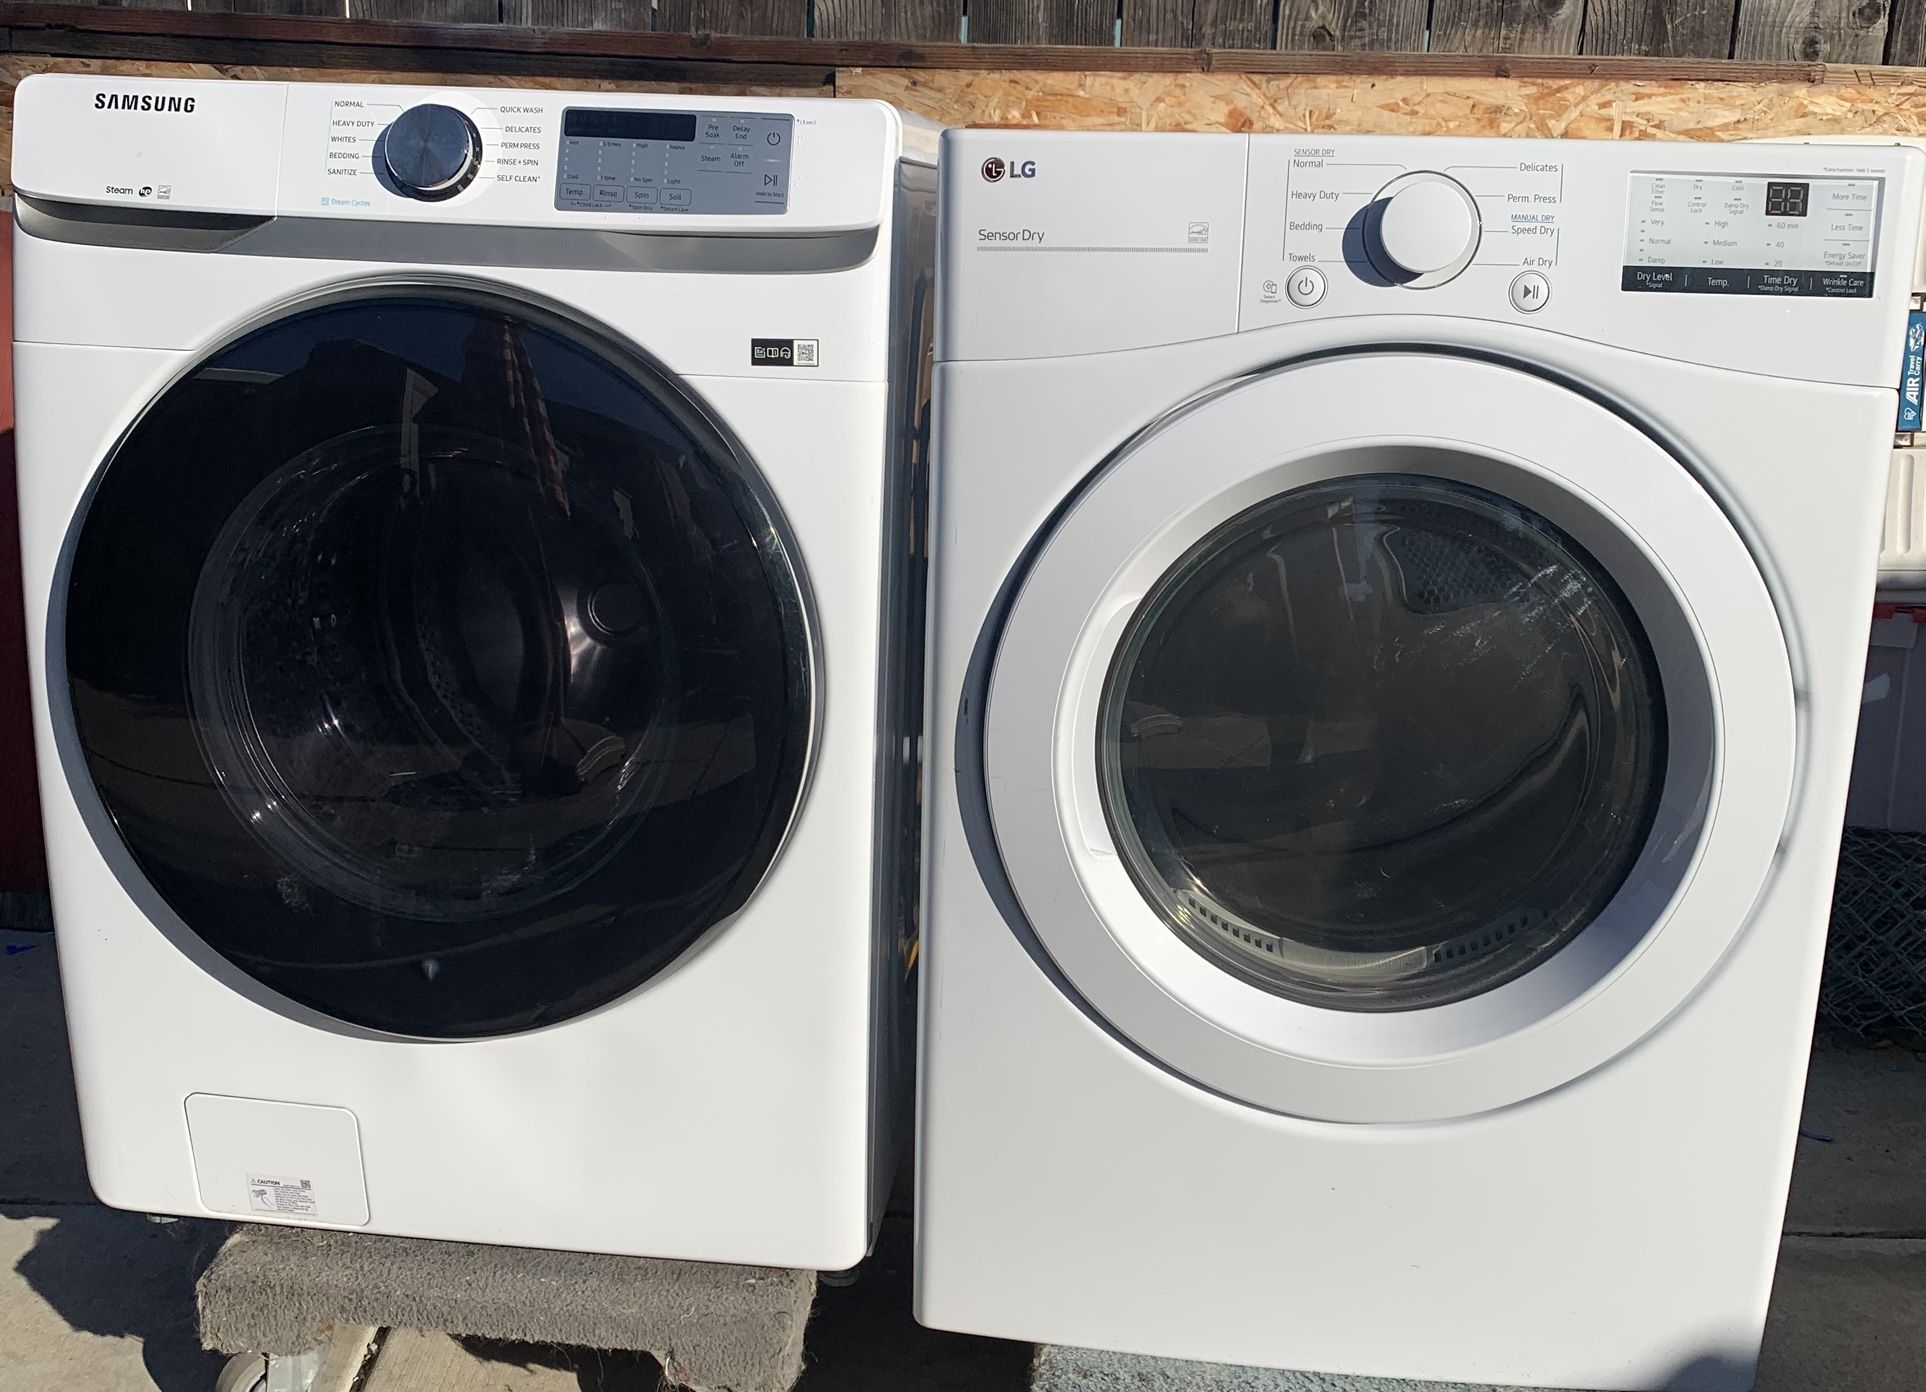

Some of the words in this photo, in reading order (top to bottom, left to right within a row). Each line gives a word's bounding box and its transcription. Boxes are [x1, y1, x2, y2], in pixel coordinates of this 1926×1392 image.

[94, 93, 196, 113] SAMSUNG
[334, 100, 365, 109] NORMAL
[500, 106, 522, 114] QUICK
[332, 120, 355, 128] HEAVY
[505, 126, 542, 134] DELICATES
[733, 125, 750, 133] Delay
[329, 152, 360, 160] BEDDING
[1293, 159, 1323, 168] Normal
[1520, 163, 1558, 172] Delicates
[327, 168, 357, 176] SANITIZE
[1010, 161, 1036, 178] LG
[106, 186, 133, 195] Steam
[634, 191, 649, 200] Spin
[1291, 190, 1317, 201] Heavy
[1319, 190, 1340, 201] Duty
[1508, 194, 1531, 203] Perm.
[1534, 194, 1557, 203] Press
[331, 198, 350, 206] Steam
[1289, 222, 1323, 232] Bedding
[1714, 220, 1729, 228] High
[1511, 226, 1537, 235] Speed
[1540, 226, 1555, 237] Dry
[1288, 253, 1316, 262] Towels
[1647, 256, 1666, 264] Damp
[1824, 251, 1846, 261] Energy
[1523, 257, 1536, 266] Air
[1538, 258, 1553, 269] Dry
[1637, 272, 1651, 281] Dry
[1652, 272, 1673, 281] Level
[1763, 275, 1781, 284] Time
[1783, 276, 1798, 286] Dry
[1707, 277, 1729, 287] Temp.
[1823, 278, 1847, 286] Wrinkle
[1907, 355, 1916, 376] Travel
[1914, 356, 1923, 376] Carry
[1906, 377, 1919, 405] AIR
